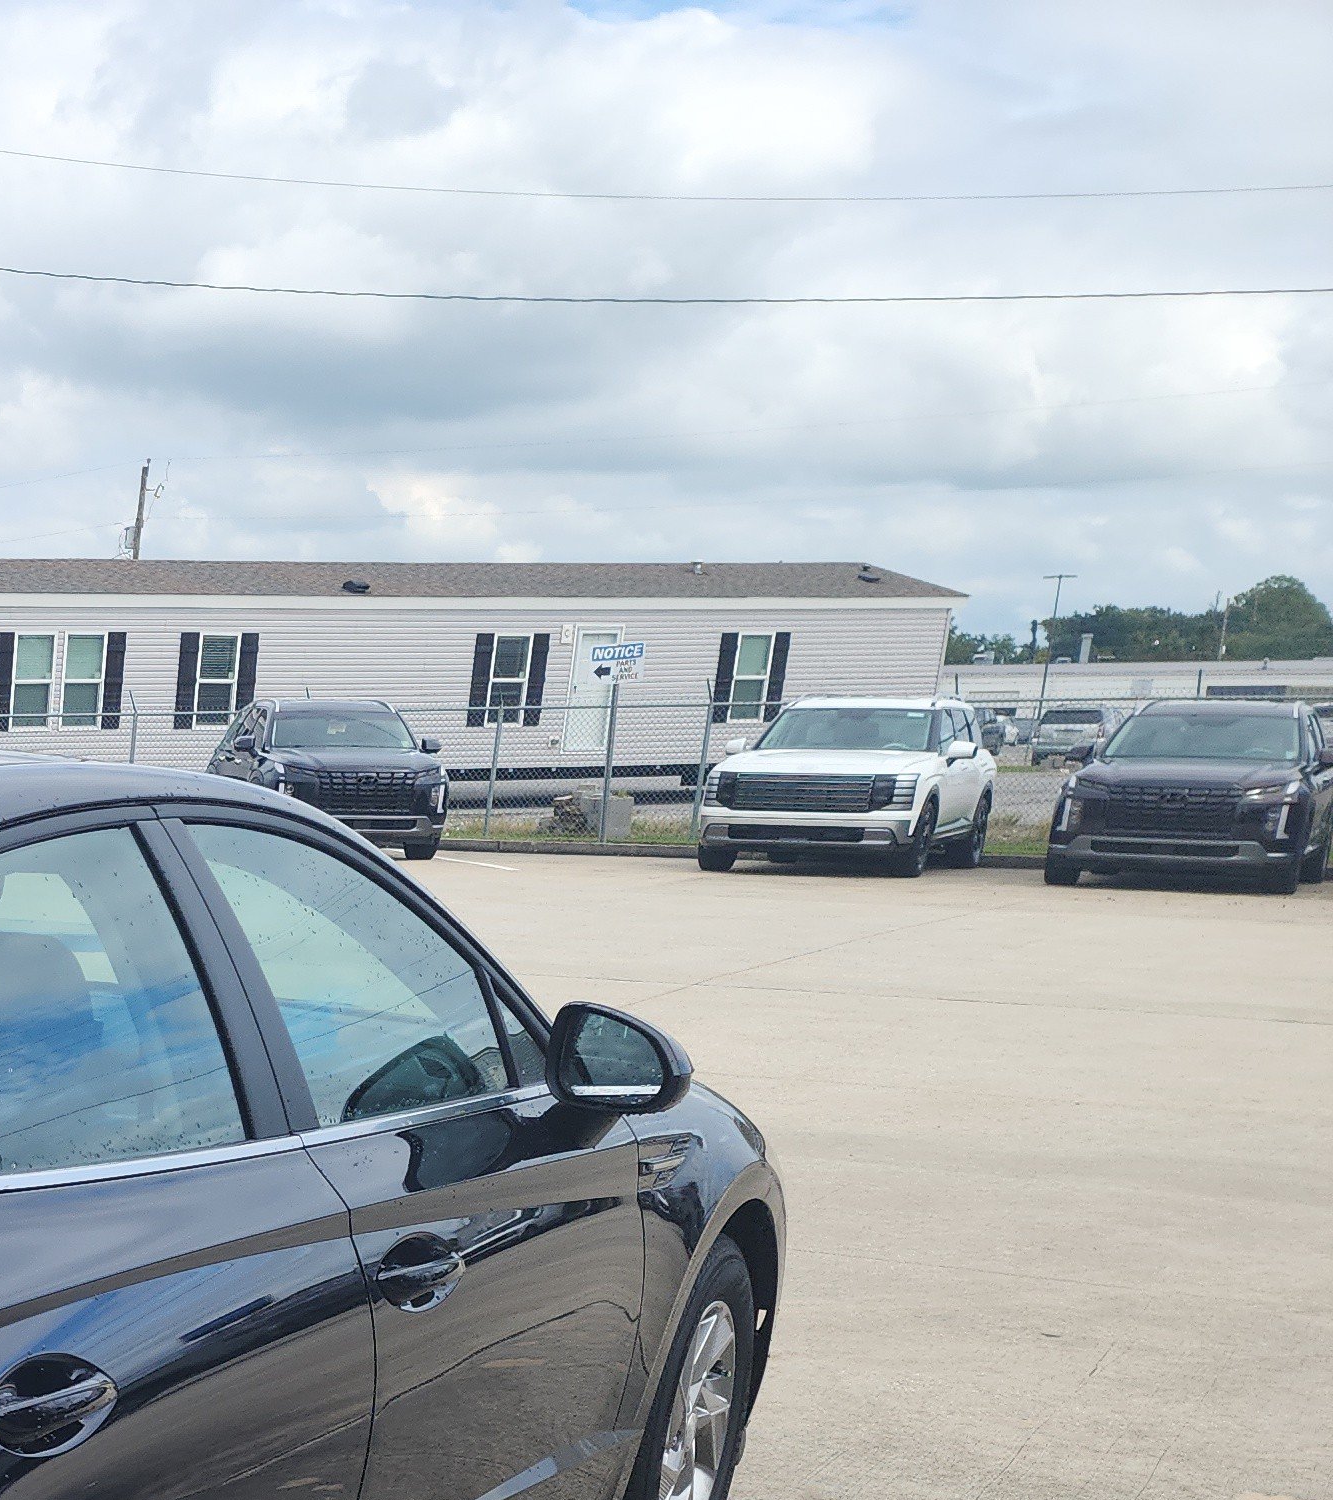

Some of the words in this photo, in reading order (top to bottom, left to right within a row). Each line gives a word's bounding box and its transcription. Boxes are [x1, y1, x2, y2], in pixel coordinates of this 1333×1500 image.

[593, 644, 643, 660] NOTICE
[615, 659, 637, 668] PARTS
[618, 666, 633, 674] AND
[611, 673, 638, 682] SERVICE
